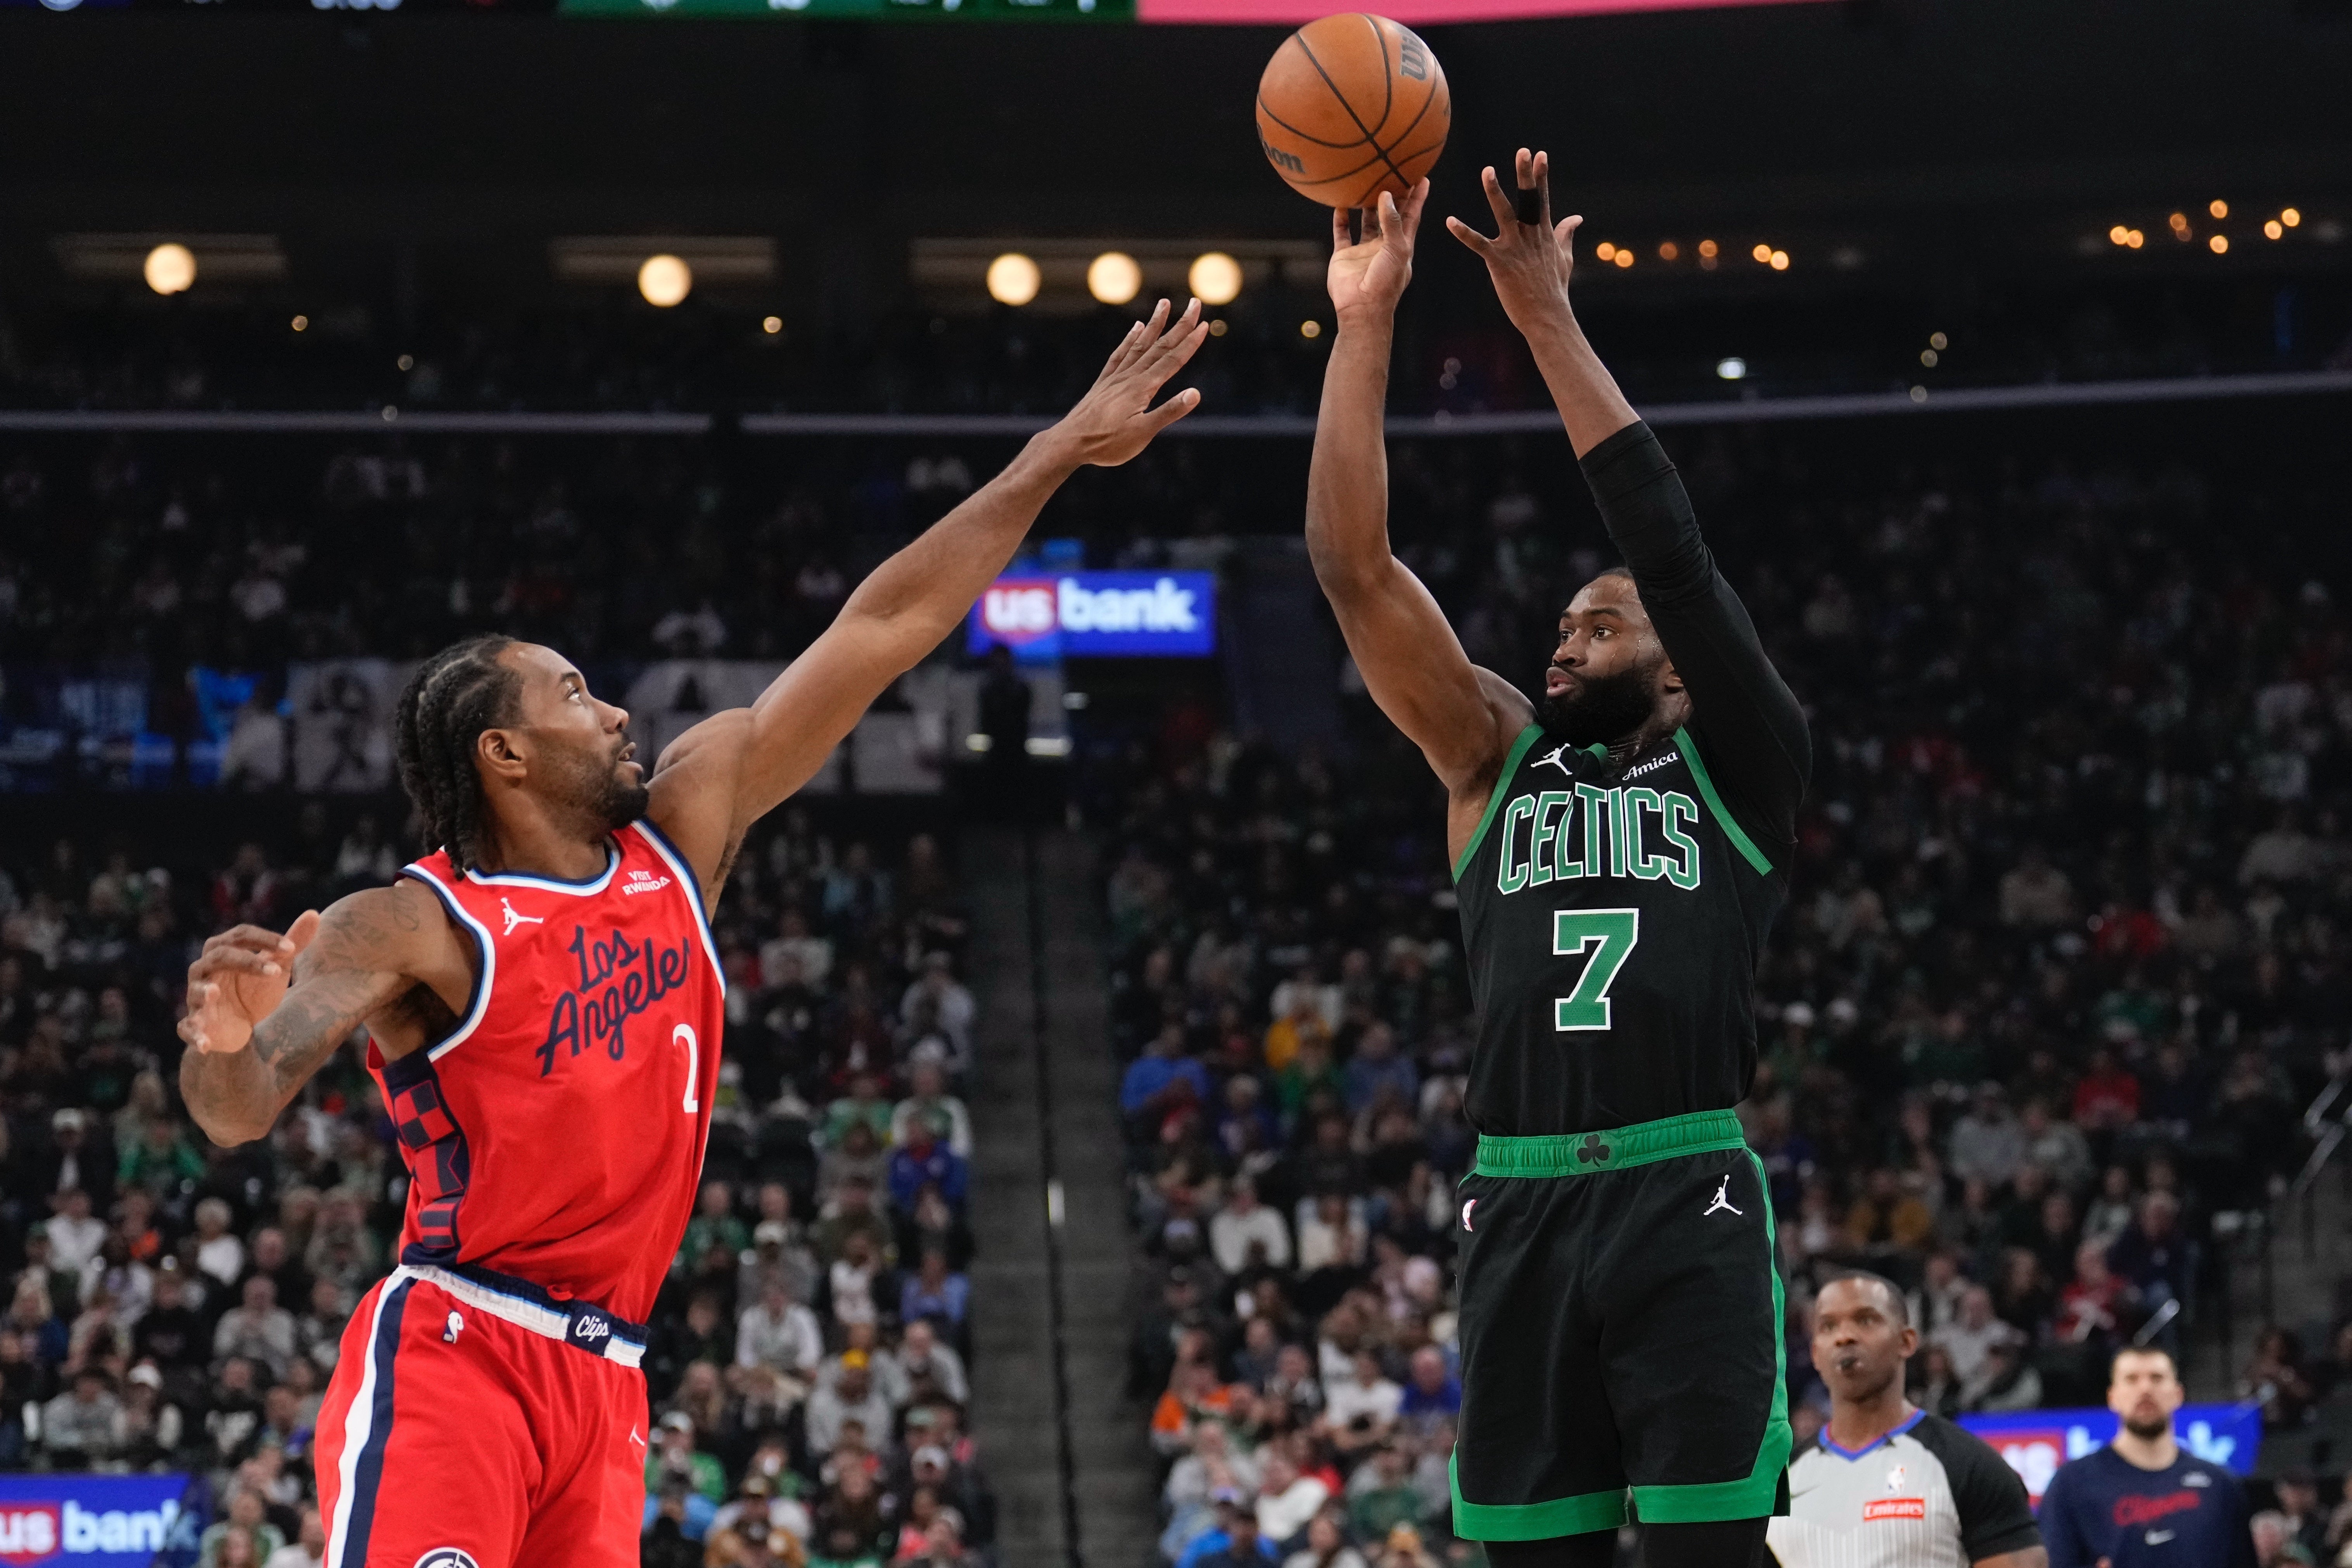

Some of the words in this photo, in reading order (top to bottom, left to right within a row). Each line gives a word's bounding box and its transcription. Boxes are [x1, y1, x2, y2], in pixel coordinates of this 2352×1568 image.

[984, 587, 1054, 633] us
[1057, 577, 1198, 633] bank
[1622, 751, 1678, 781] Amica
[1497, 782, 1700, 895] CELTICS
[622, 876, 671, 896] RWANDA
[627, 870, 652, 881] VISIT
[569, 924, 639, 994] Los
[1553, 908, 1639, 1031] 7
[672, 1023, 698, 1113] 2
[575, 1315, 609, 1342] Clips
